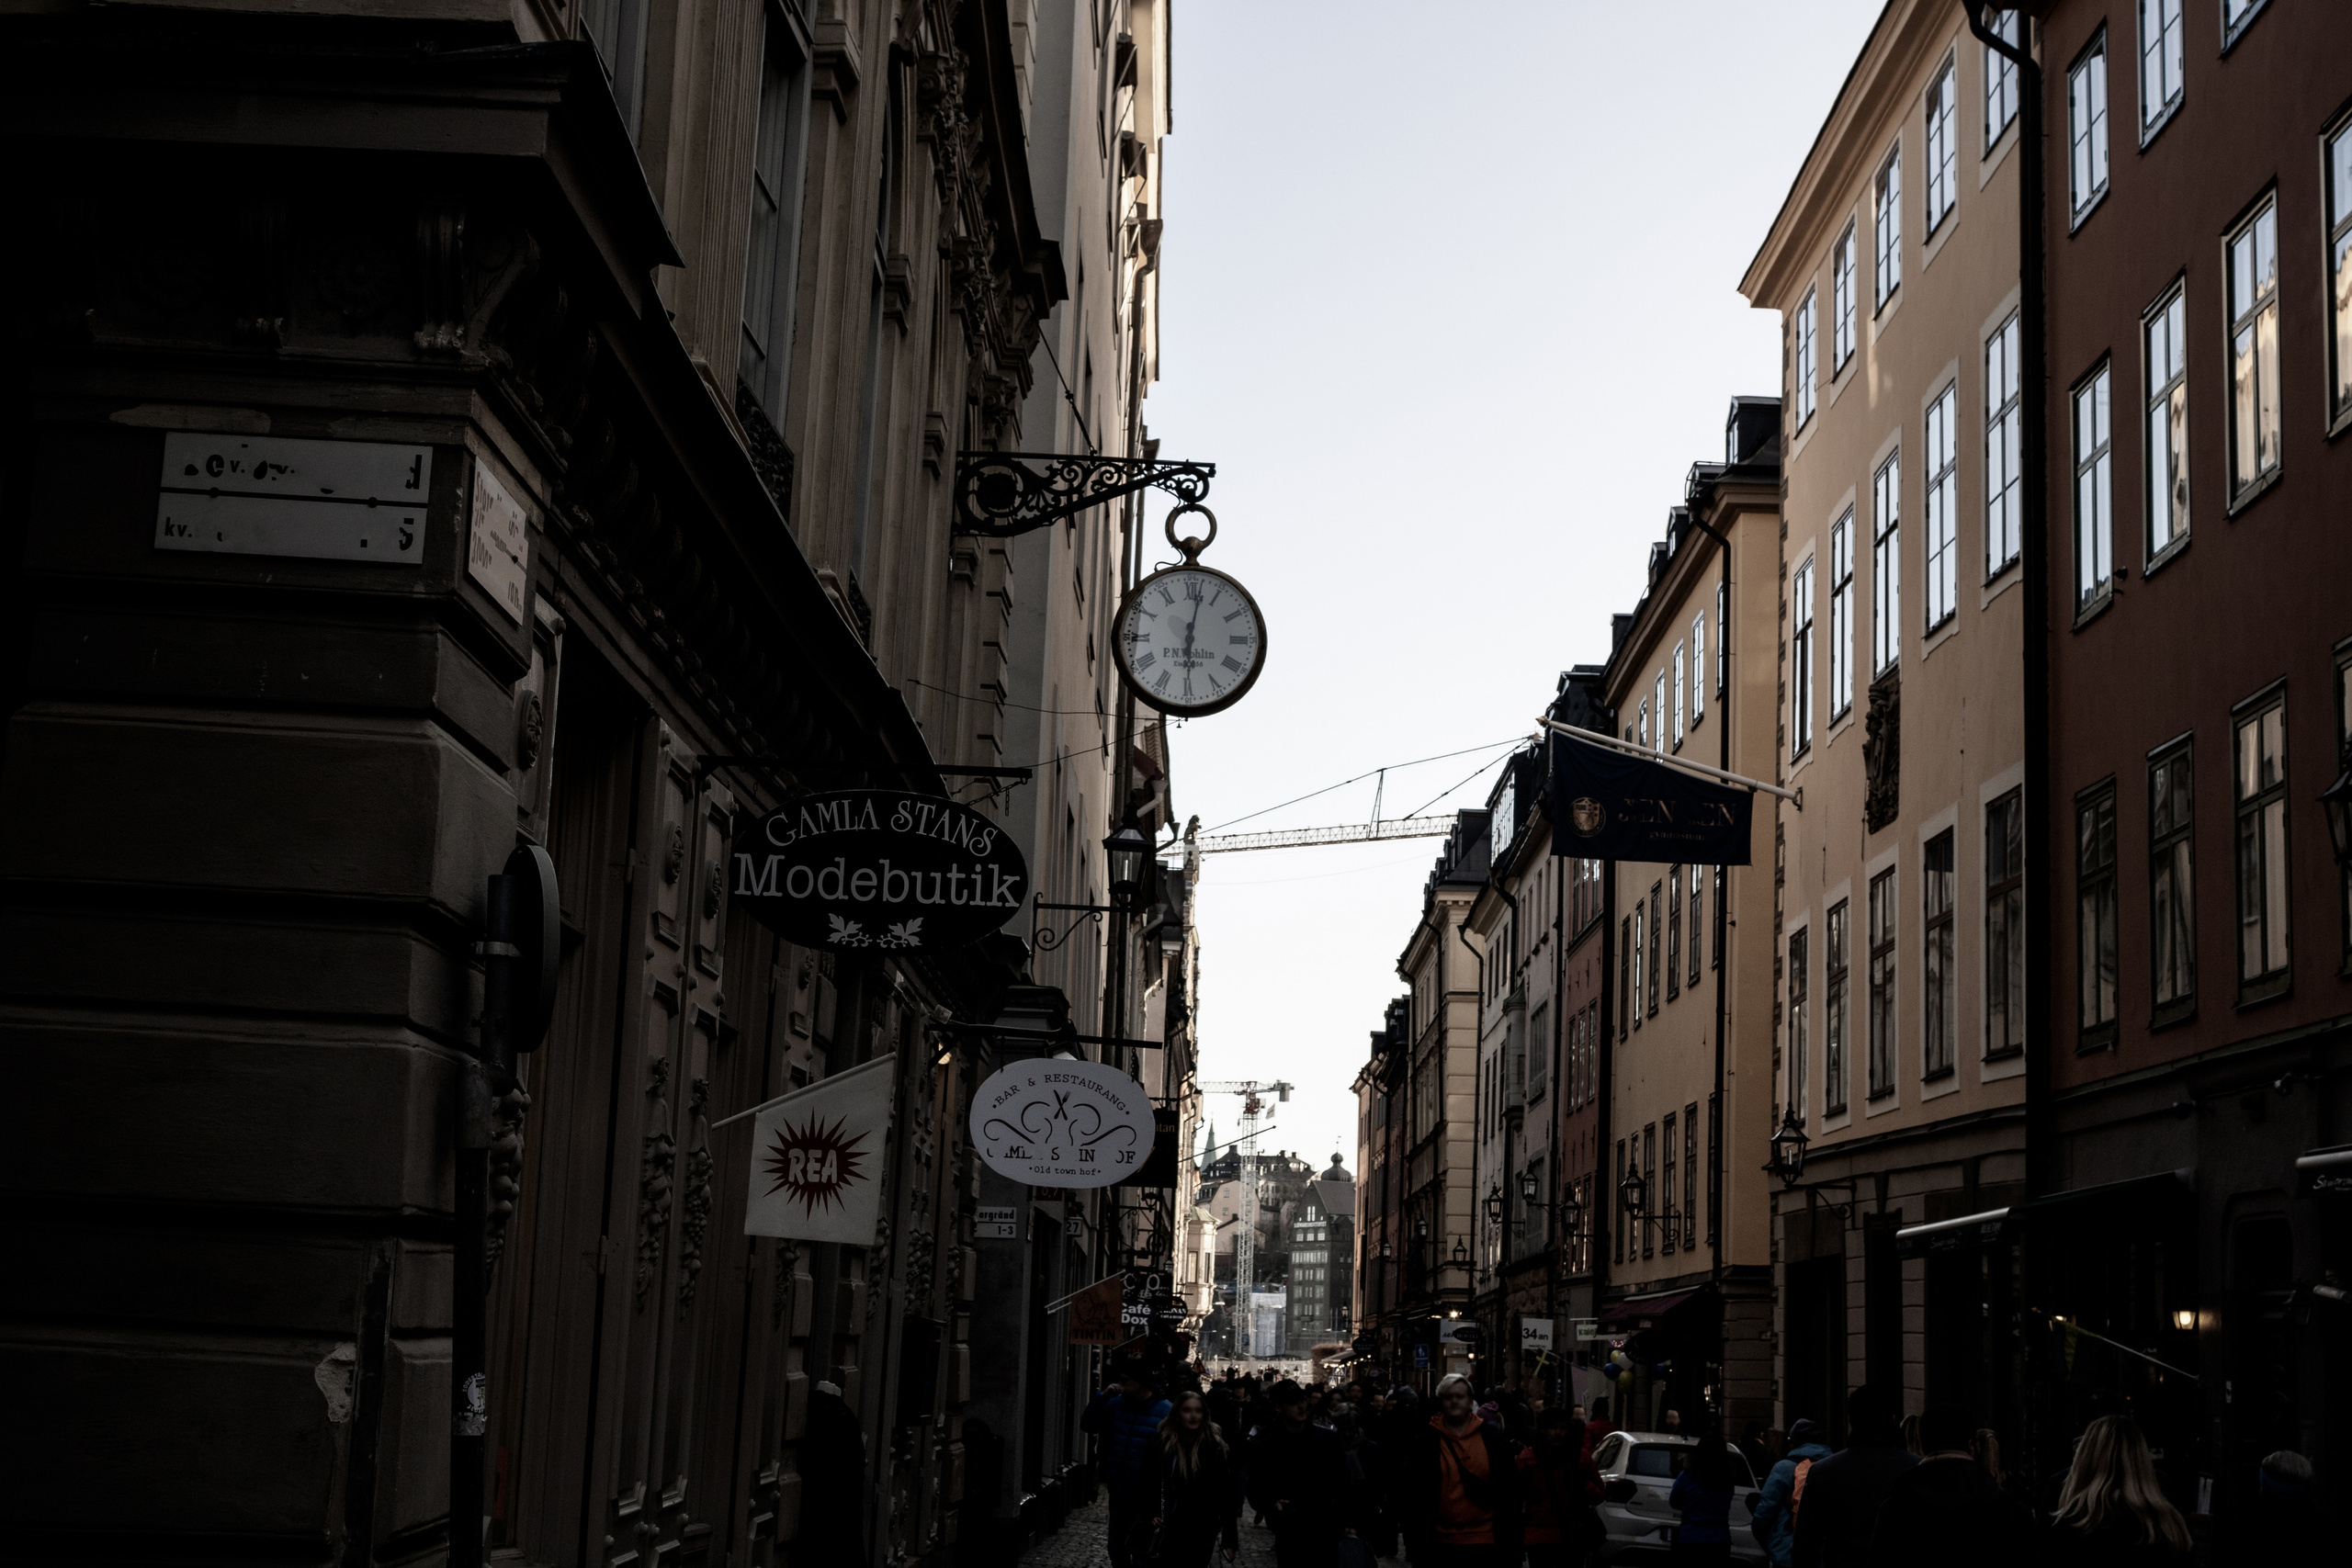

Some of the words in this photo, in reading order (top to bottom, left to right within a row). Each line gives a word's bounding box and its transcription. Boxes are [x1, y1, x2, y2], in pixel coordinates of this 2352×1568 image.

[765, 797, 881, 847] GAMLA
[889, 799, 1000, 857] STANS
[734, 852, 1022, 908] Modebutik
[994, 1084, 1021, 1106] BAR
[1027, 1077, 1036, 1087] &
[1044, 1073, 1126, 1112] RESTAURANG
[787, 1147, 838, 1185] REA
[1035, 1166, 1051, 1175] Old
[1055, 1167, 1077, 1176] town
[1080, 1168, 1096, 1177] hof
[998, 1225, 1013, 1235] 1-3
[1121, 1314, 1148, 1325] Dox
[1073, 1328, 1116, 1340] TINTIN
